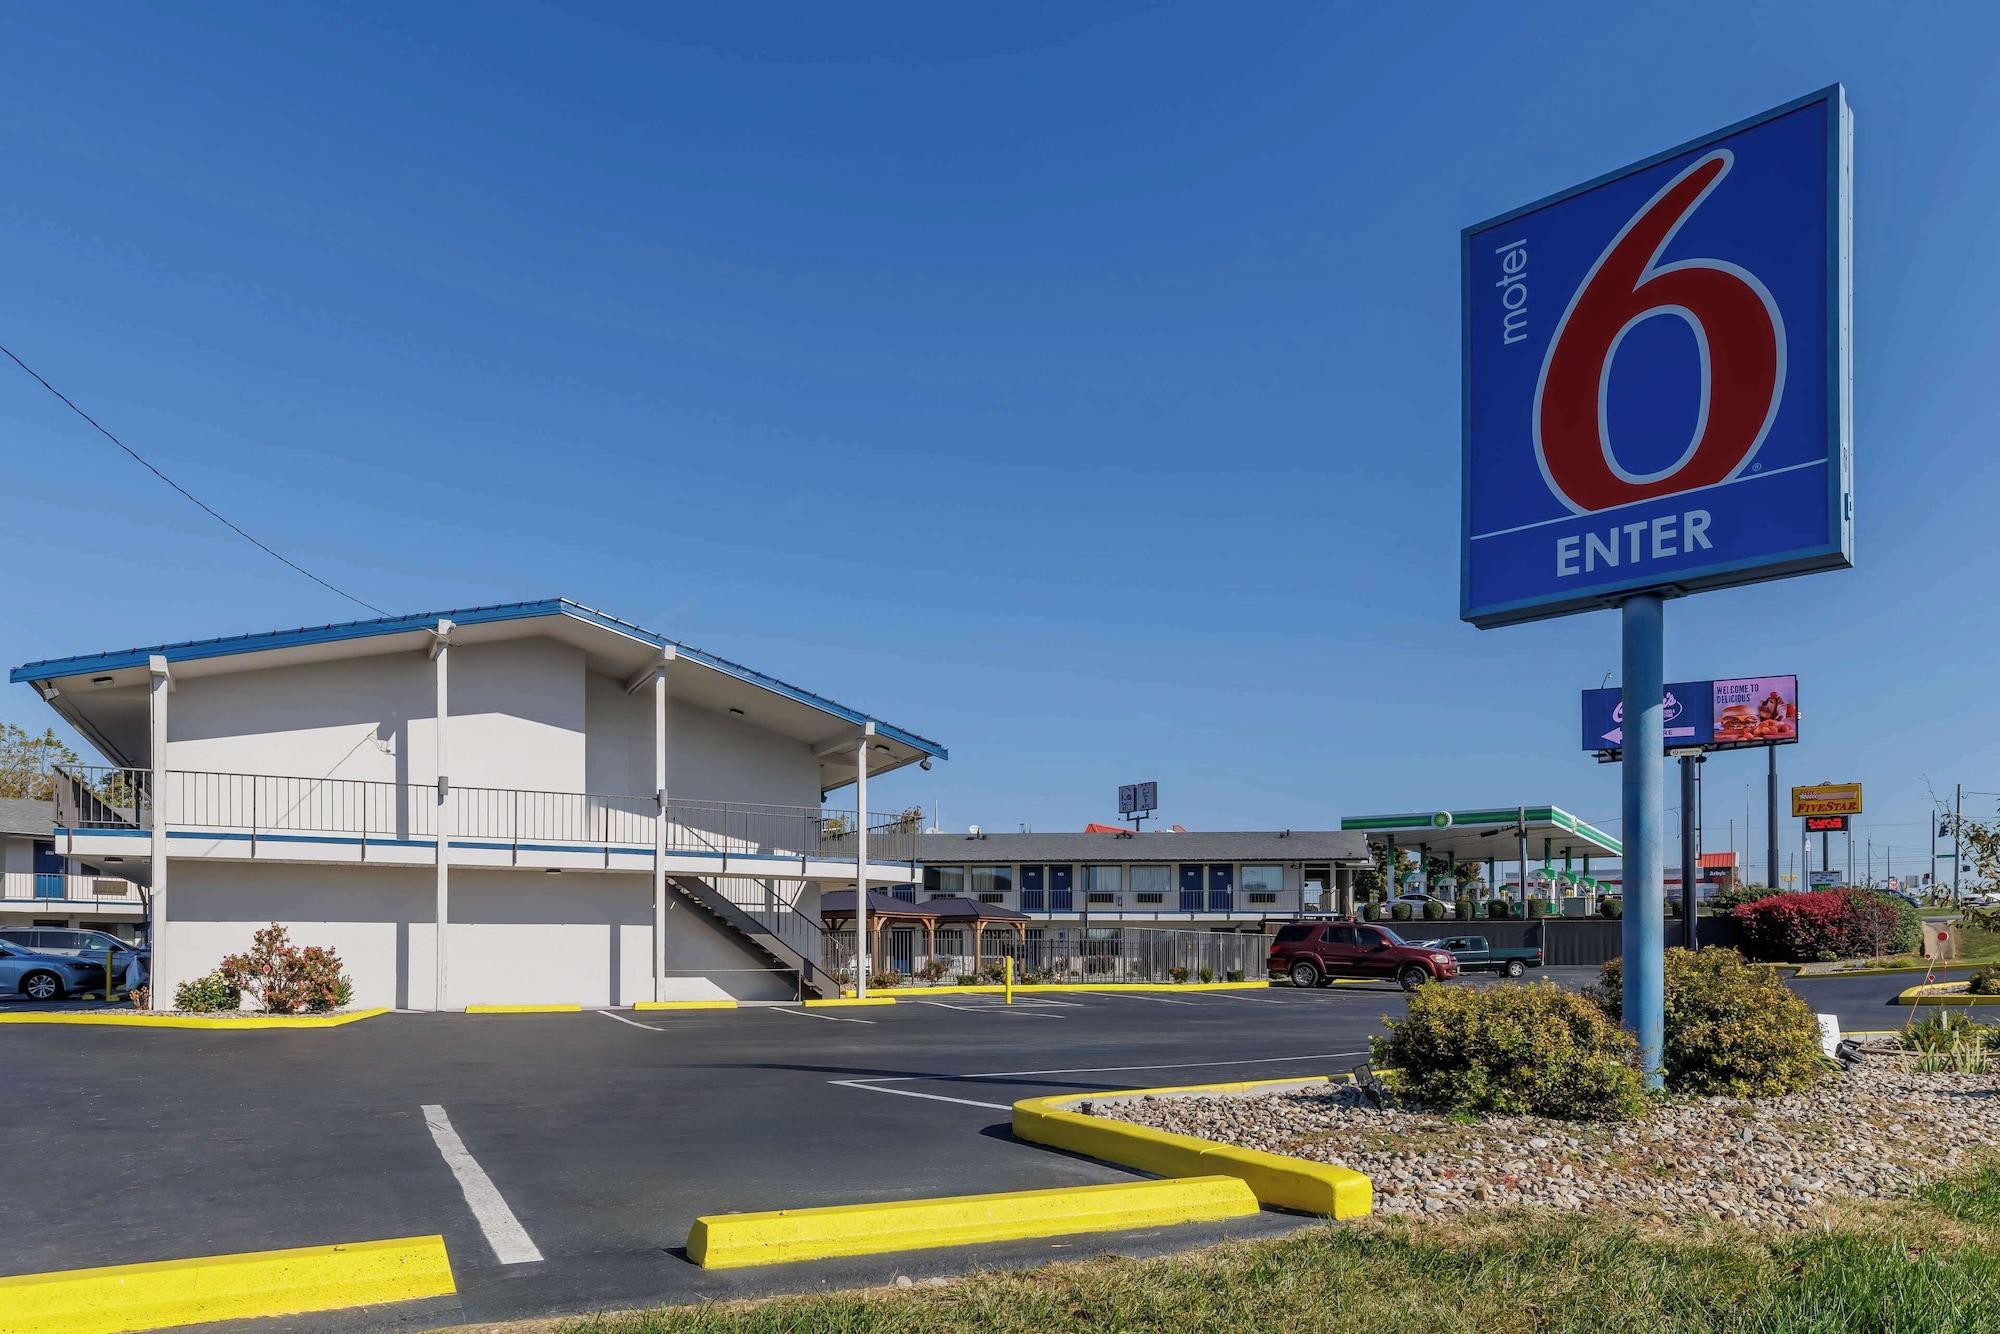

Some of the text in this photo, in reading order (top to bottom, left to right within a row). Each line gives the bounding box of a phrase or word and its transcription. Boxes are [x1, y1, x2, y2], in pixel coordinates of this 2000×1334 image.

[1496, 238, 1527, 345] motel
[1532, 148, 1787, 516] 6
[1556, 509, 1714, 578] ENTER
[1716, 683, 1760, 695] WELCOME TO
[1716, 693, 1751, 704] DELICIOUS
